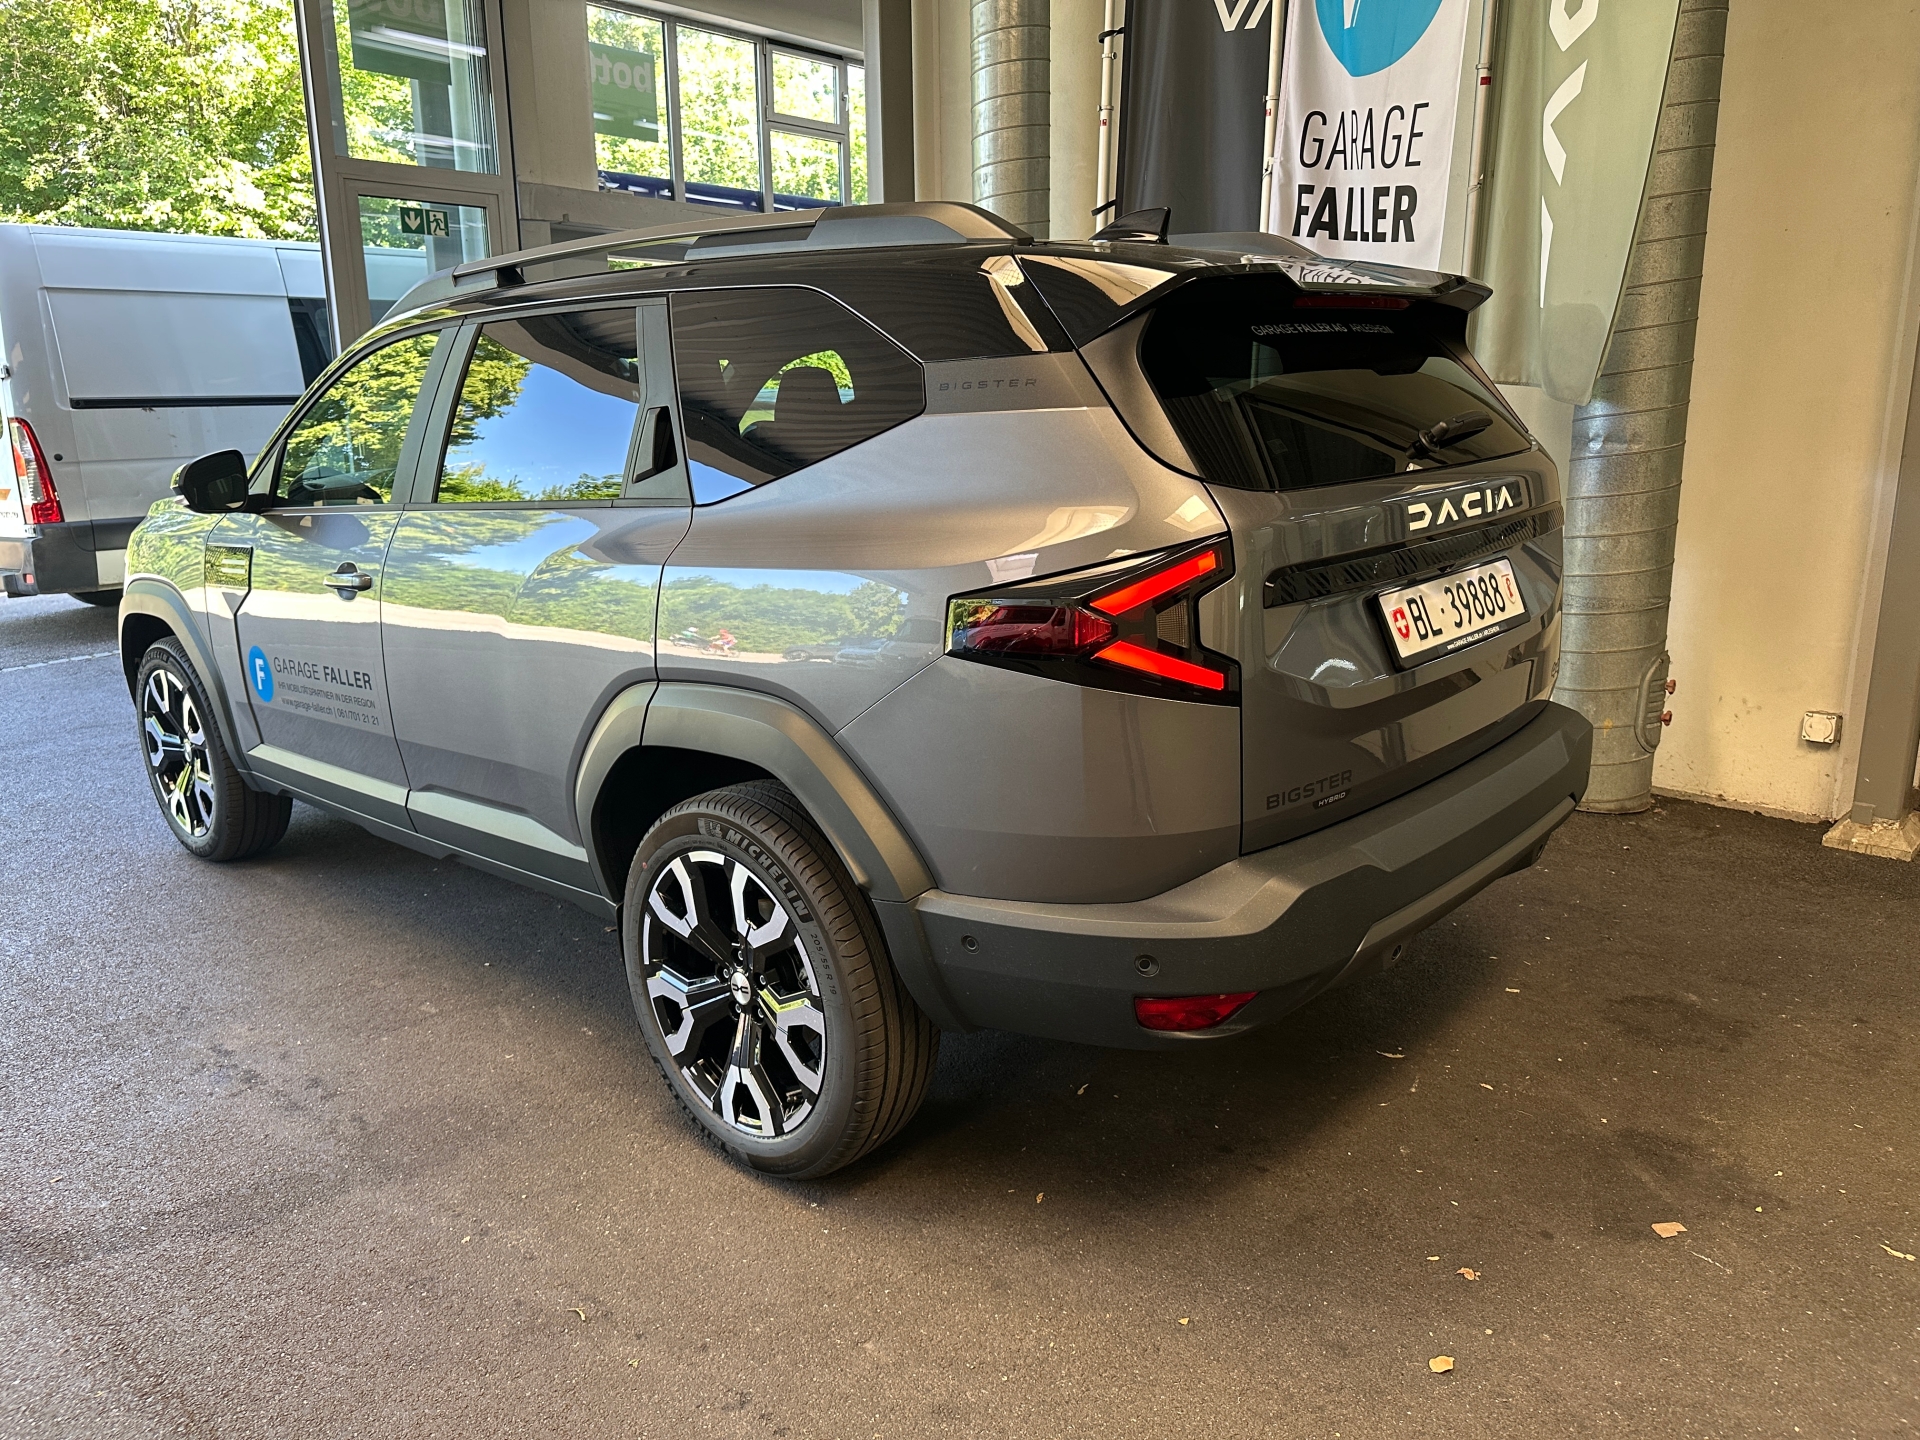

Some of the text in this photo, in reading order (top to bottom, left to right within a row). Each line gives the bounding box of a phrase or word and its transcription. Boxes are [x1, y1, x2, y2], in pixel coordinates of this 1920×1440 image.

[1299, 102, 1430, 171] GARAGE
[1291, 183, 1418, 243] FALLER
[1250, 324, 1298, 336] GARAGE
[1294, 323, 1335, 333] FALLER
[1331, 323, 1348, 333] AG
[938, 378, 1037, 392] BIGSTER
[1407, 485, 1514, 531] DACIA
[1406, 572, 1506, 642] BL 39888
[255, 658, 266, 690] F
[273, 656, 373, 691] GARAGE FALLER
[337, 709, 361, 722] 061/701
[362, 713, 370, 724] 21
[372, 715, 380, 726] 21
[341, 694, 354, 705] DER
[354, 696, 376, 709] REGION
[1266, 769, 1353, 811] BIGSTER
[1318, 791, 1347, 807] HYBRID
[726, 829, 809, 921] MICHELIN
[811, 933, 830, 970] 205/55
